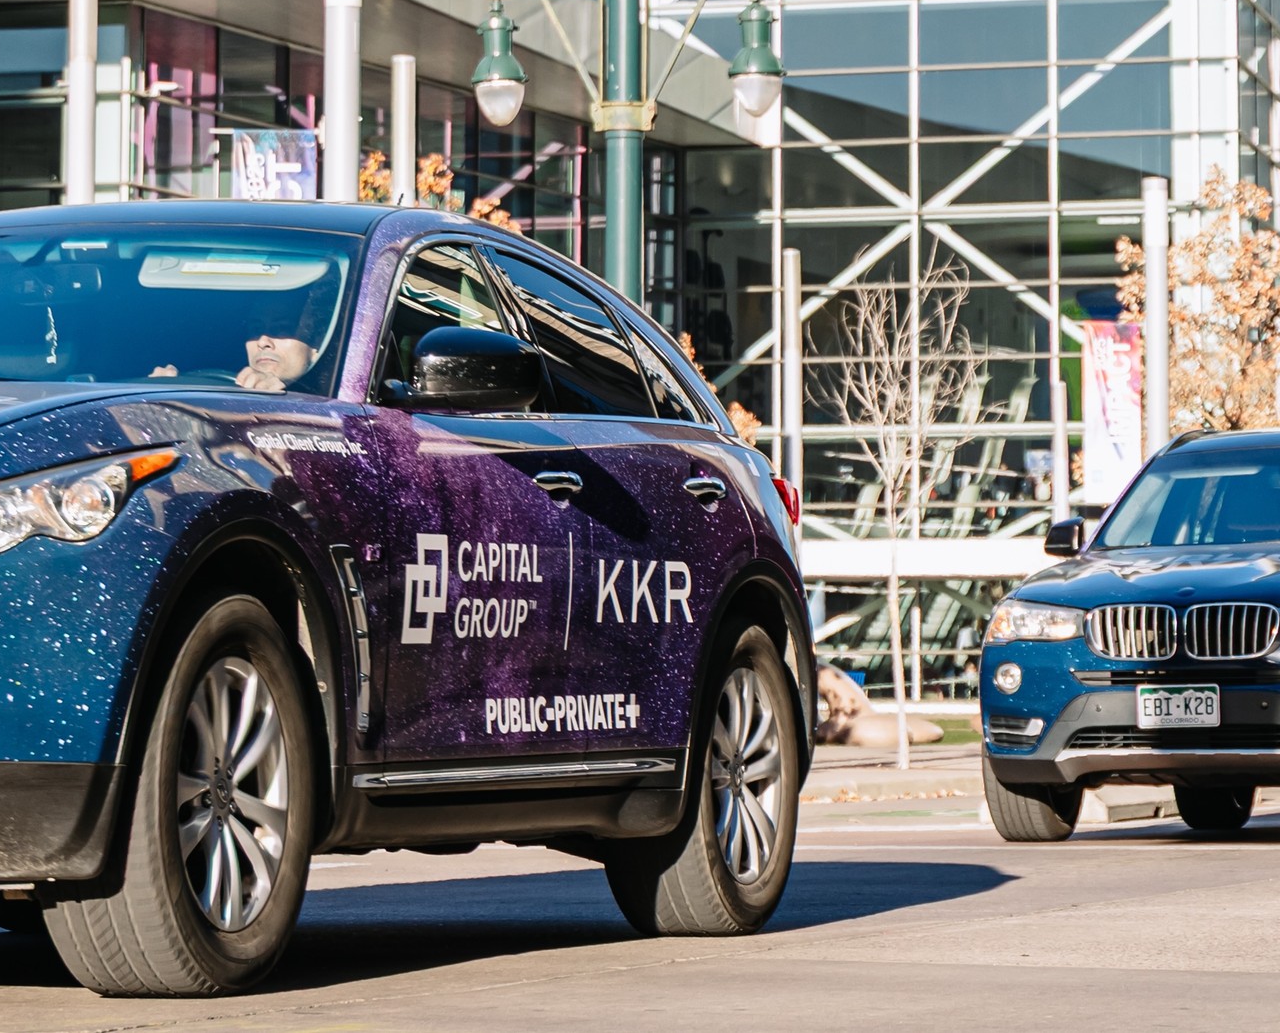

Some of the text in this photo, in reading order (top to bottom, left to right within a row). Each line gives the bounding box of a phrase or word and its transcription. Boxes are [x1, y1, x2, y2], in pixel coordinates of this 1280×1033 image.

[247, 431, 284, 453] Capital
[282, 433, 317, 452] Client
[345, 438, 368, 455] Inc.
[458, 540, 543, 583] CAPITAL
[596, 559, 694, 623] KKR
